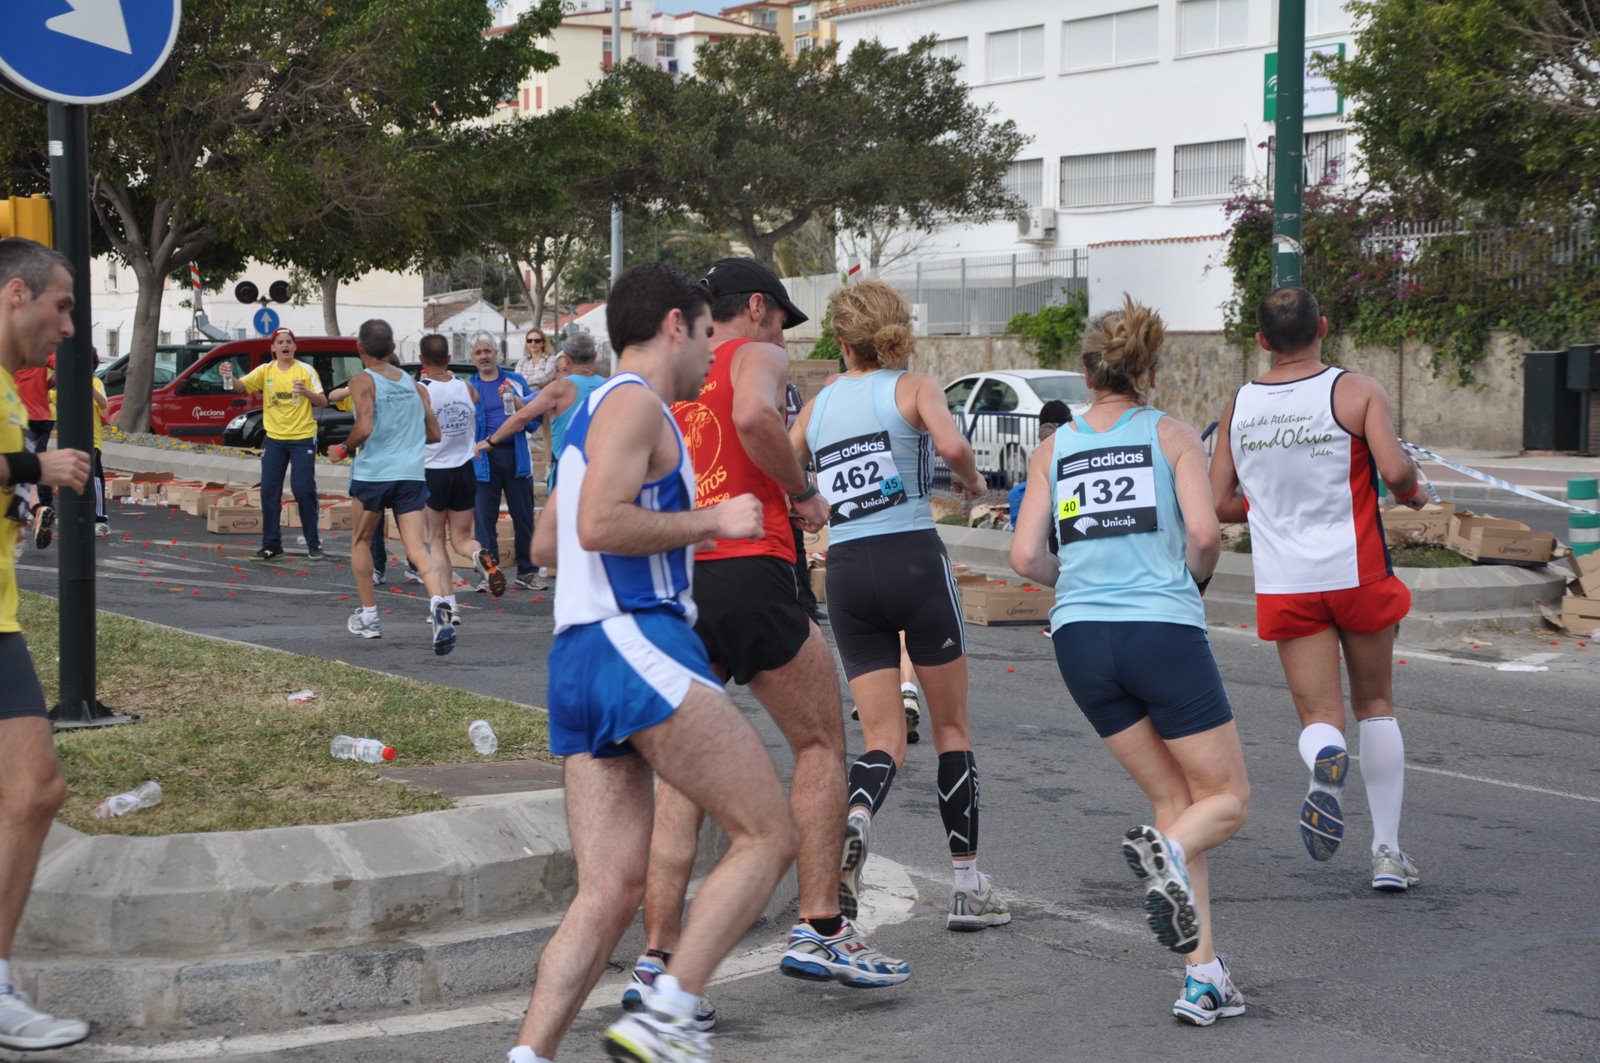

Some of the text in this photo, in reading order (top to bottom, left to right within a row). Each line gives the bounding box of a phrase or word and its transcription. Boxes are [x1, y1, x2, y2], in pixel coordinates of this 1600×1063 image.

[1237, 413, 1313, 431] Club de Atletismo
[841, 440, 885, 458] adidas
[1310, 446, 1334, 459] Jaén
[1090, 451, 1145, 468] adidas
[832, 460, 884, 494] 462
[884, 478, 898, 491] 45
[1072, 476, 1136, 508] 132
[861, 495, 890, 509] Unicaja
[1063, 500, 1076, 513] 40
[1101, 515, 1136, 528] Unicaja
